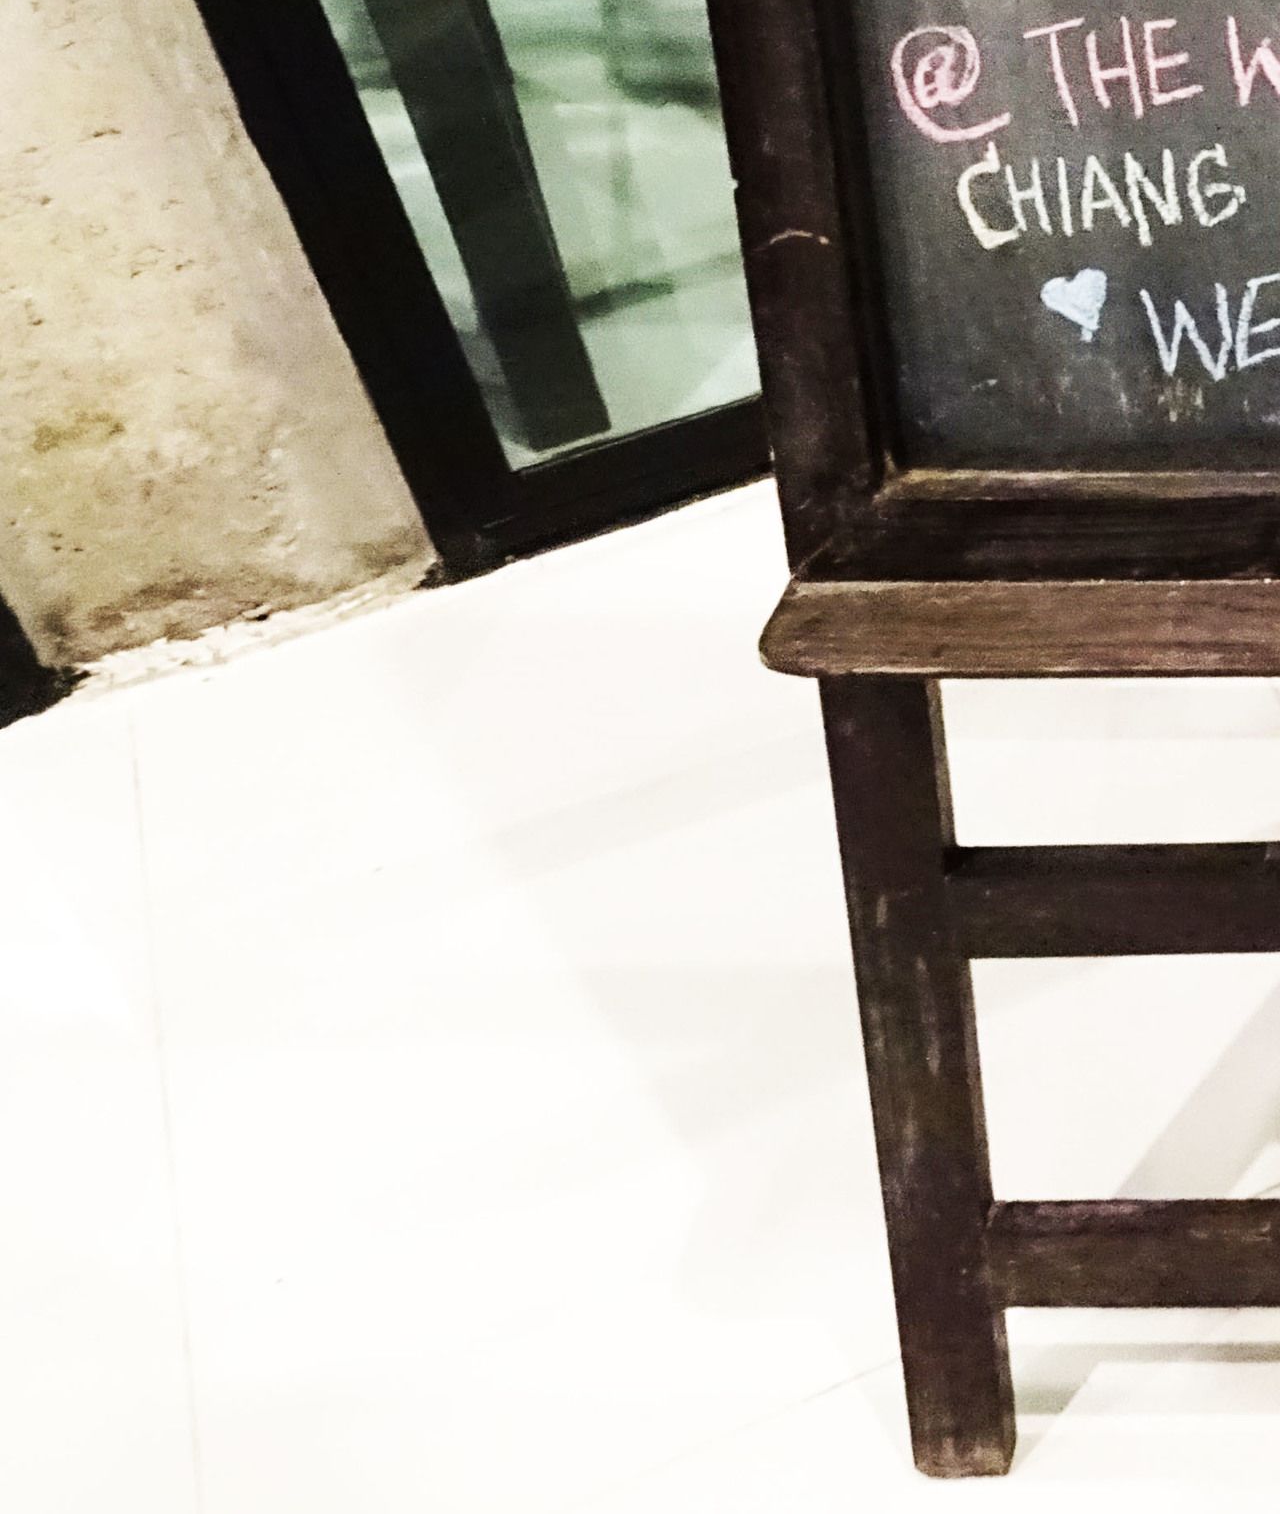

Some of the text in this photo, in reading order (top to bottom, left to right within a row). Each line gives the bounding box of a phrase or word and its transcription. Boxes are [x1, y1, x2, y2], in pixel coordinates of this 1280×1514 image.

[888, 24, 1012, 144] @
[1022, 12, 1204, 130] THE
[954, 140, 1248, 252] CHIANG
